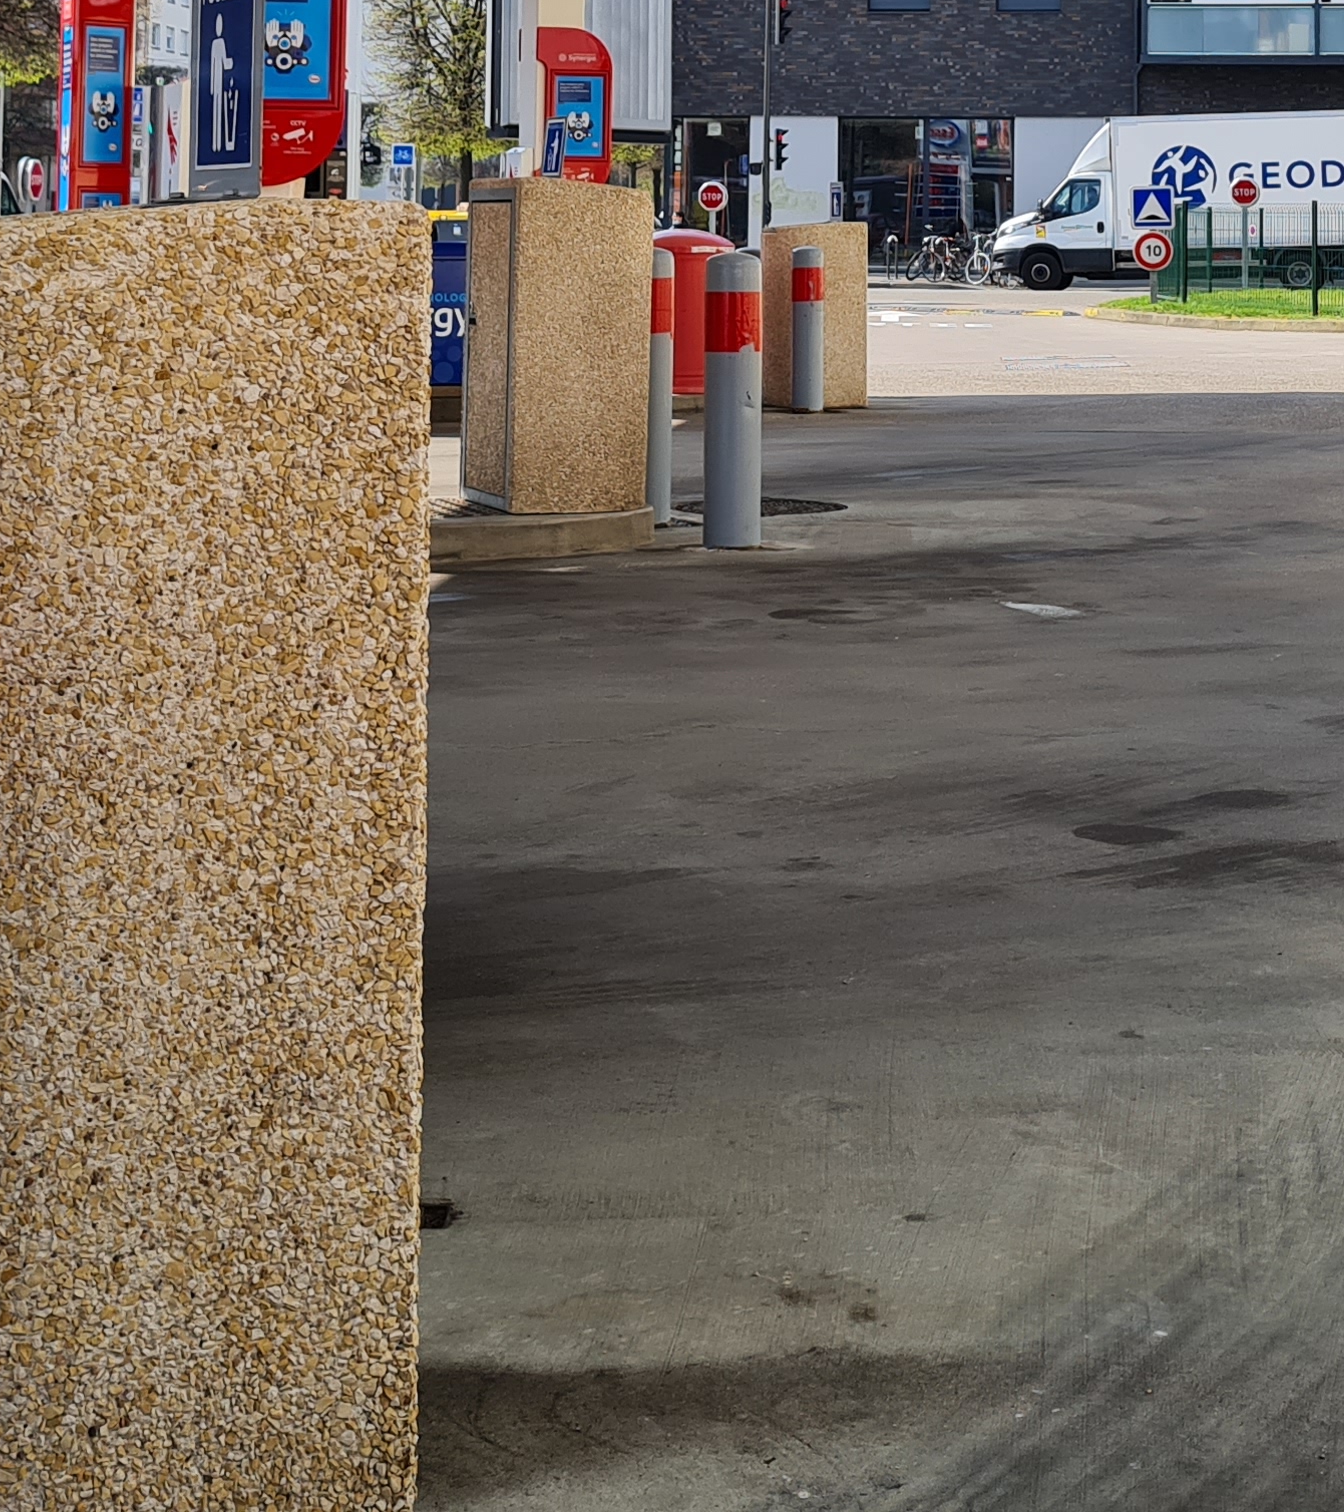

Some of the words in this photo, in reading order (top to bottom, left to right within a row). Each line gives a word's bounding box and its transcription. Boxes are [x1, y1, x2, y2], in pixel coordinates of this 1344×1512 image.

[702, 192, 722, 201] STOP
[1233, 187, 1255, 197] STOP
[1145, 244, 1162, 257] 10
